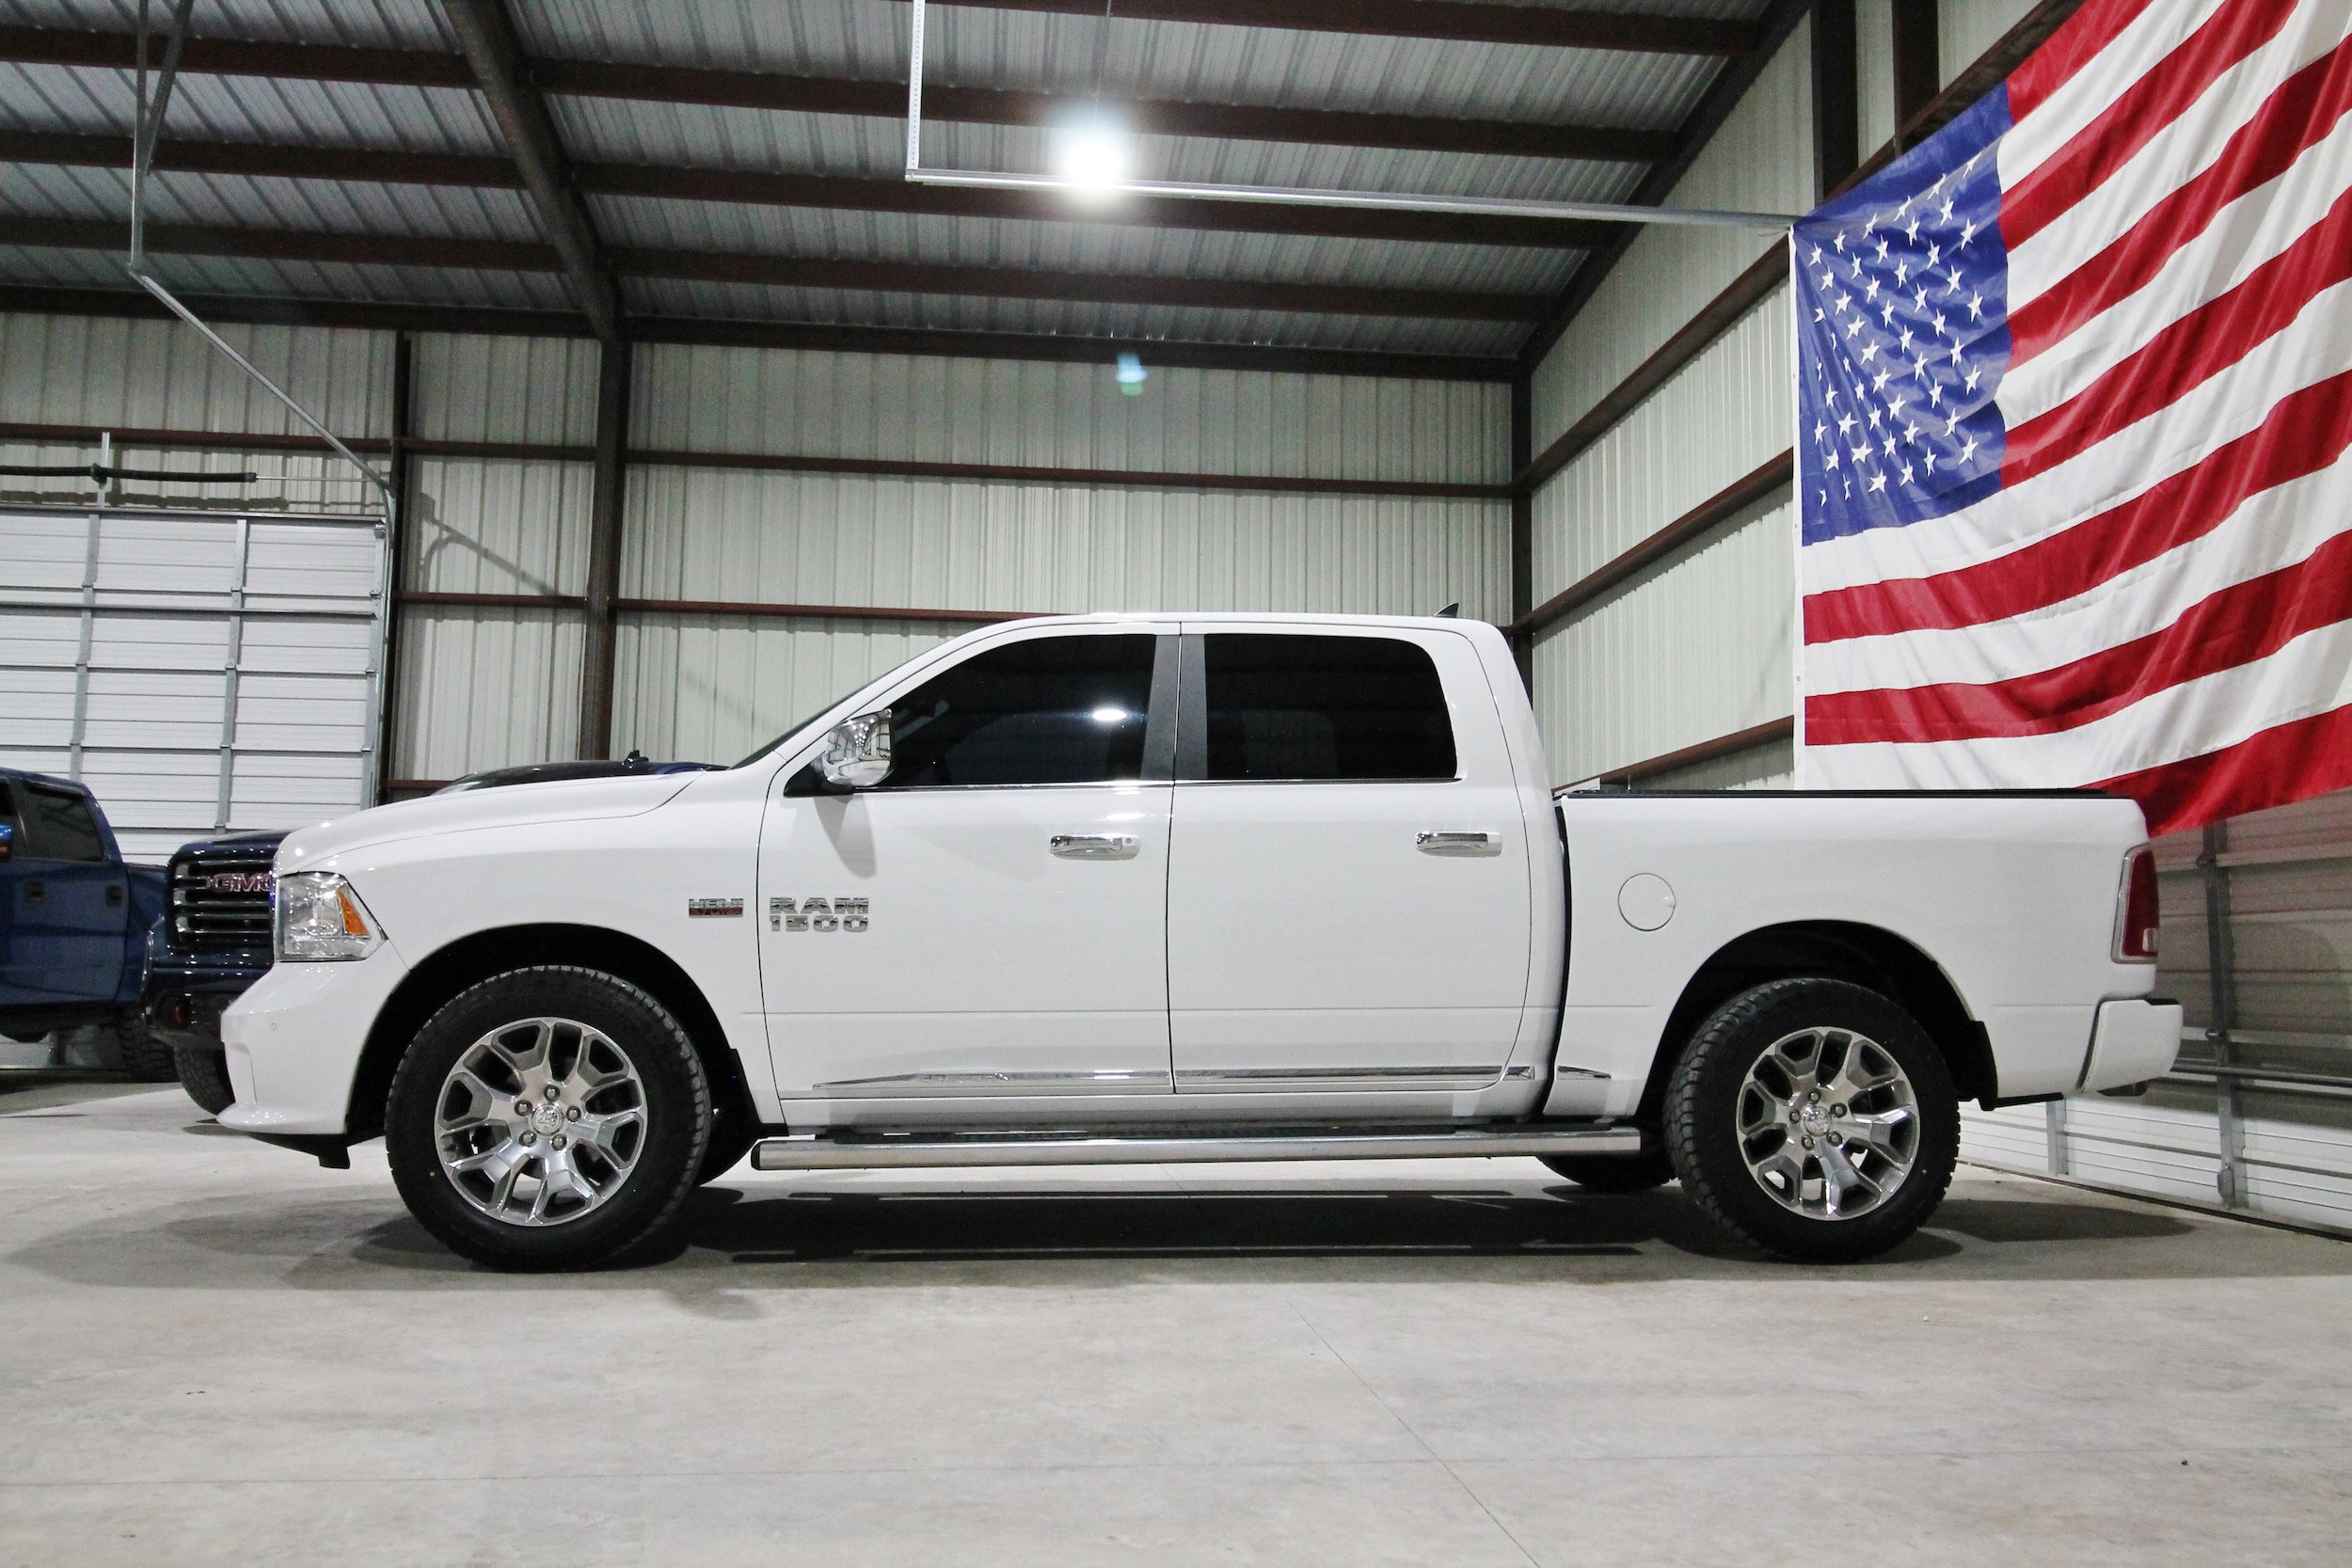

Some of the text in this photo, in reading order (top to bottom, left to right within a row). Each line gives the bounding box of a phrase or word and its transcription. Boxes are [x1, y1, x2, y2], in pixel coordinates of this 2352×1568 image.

[689, 898, 743, 908] HEMI
[770, 897, 869, 914] RAM
[770, 914, 868, 933] 1500
